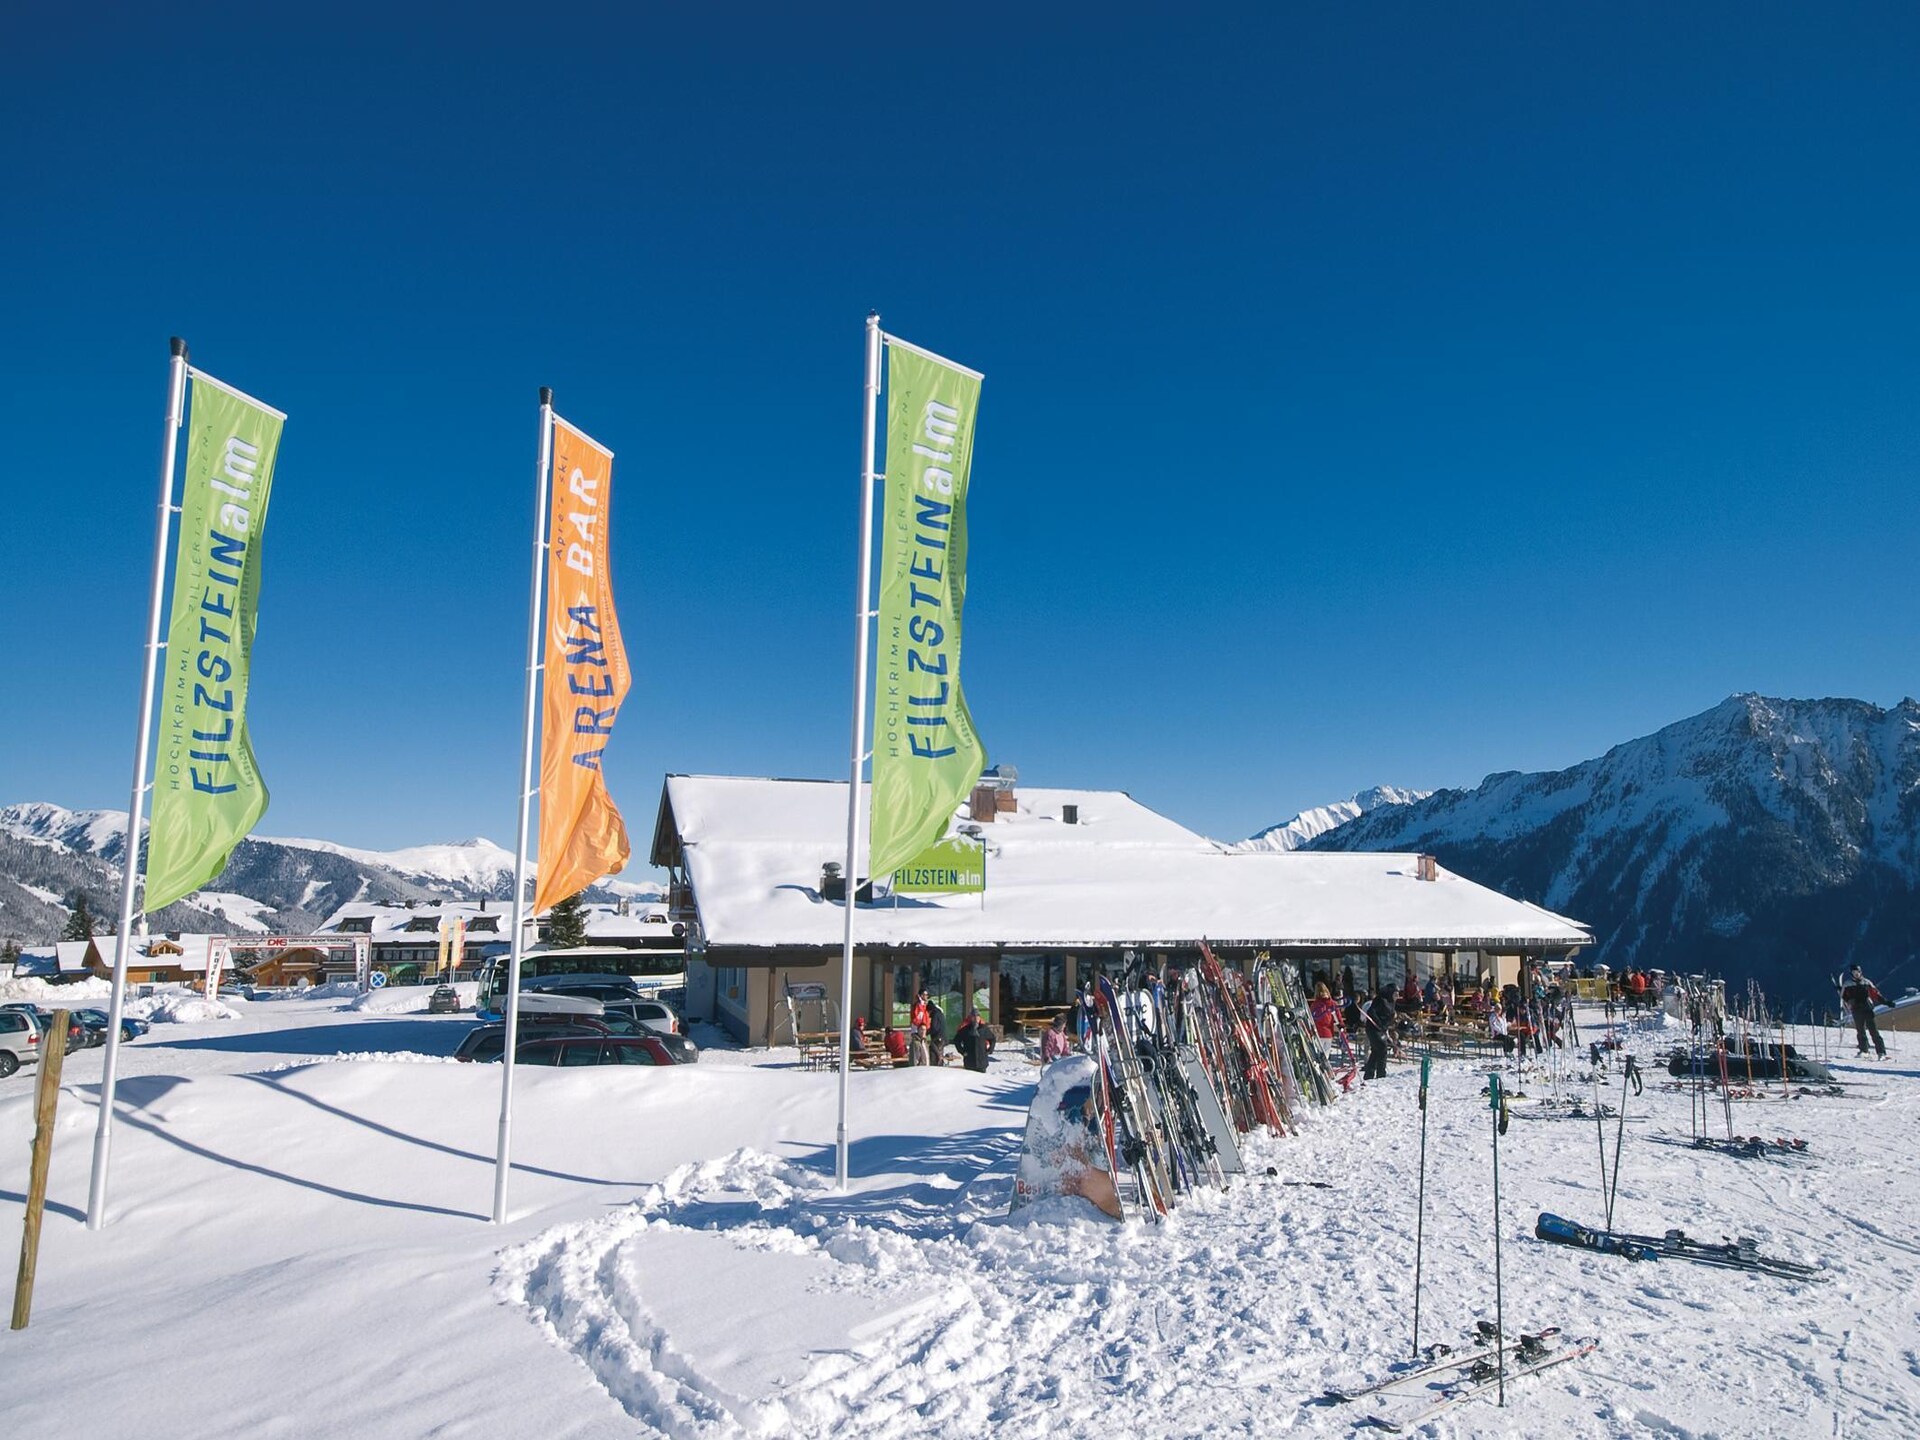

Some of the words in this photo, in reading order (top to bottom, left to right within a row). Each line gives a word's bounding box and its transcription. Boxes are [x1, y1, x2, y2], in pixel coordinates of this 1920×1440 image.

[566, 467, 598, 578] BAR
[169, 647, 191, 790] HOCHKRIMML
[566, 606, 616, 770] ARENA
[887, 613, 902, 757] HOCHKRIMML
